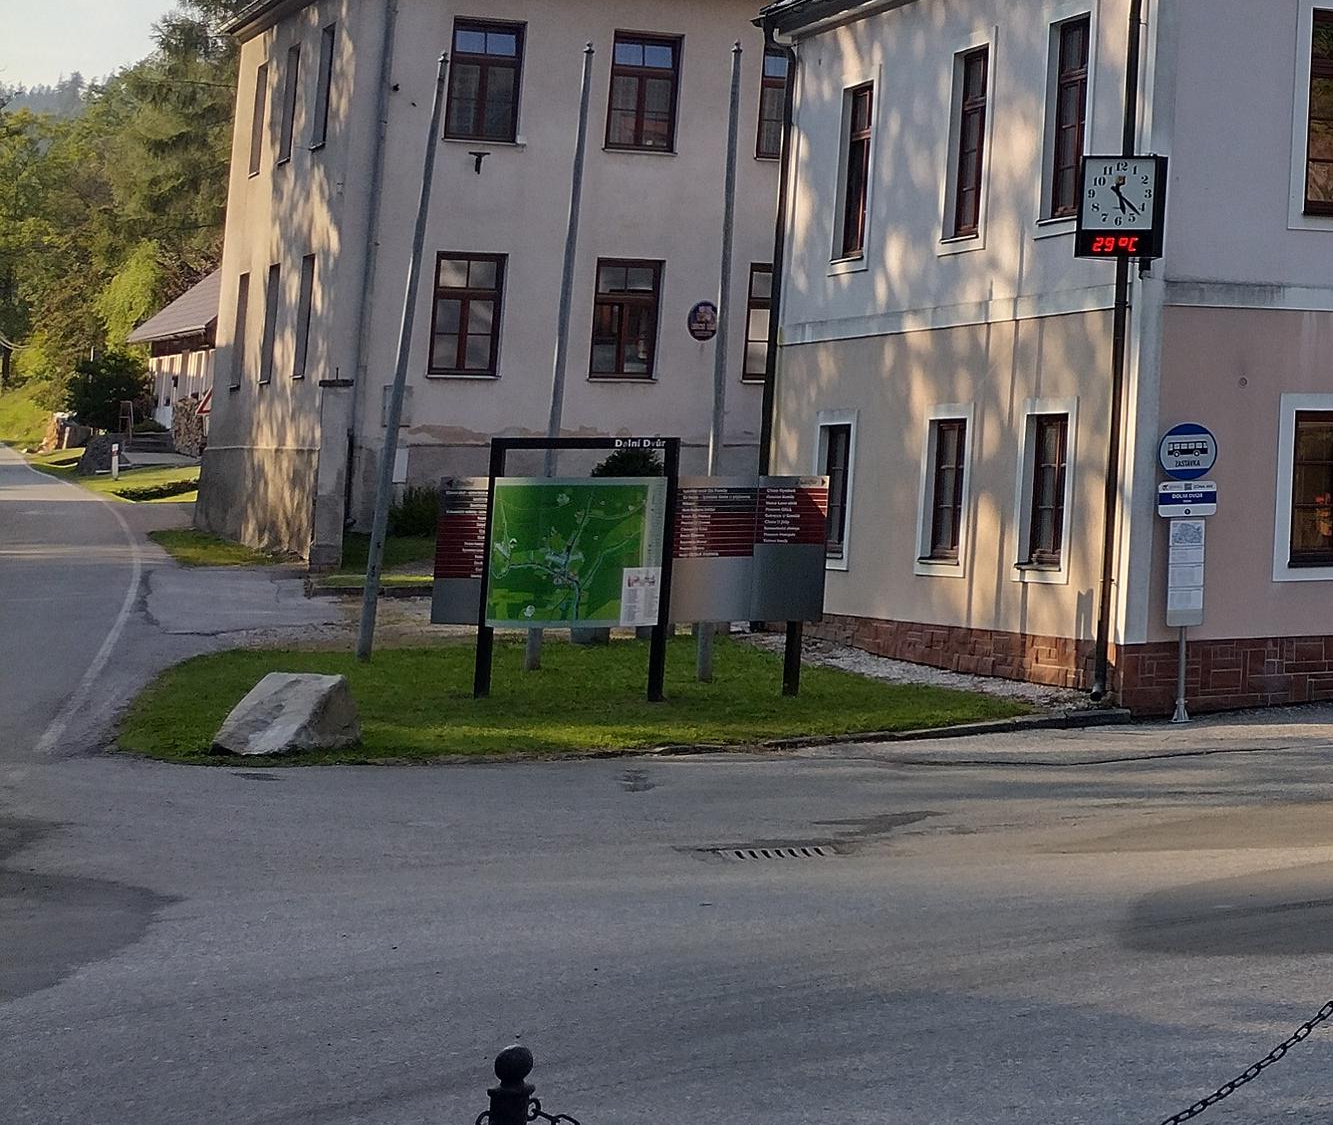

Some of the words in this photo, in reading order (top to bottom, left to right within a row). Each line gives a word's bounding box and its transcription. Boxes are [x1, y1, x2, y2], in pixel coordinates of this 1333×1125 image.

[1103, 166, 1113, 175] 11
[1116, 161, 1128, 171] 12
[1093, 176, 1106, 186] 10
[1141, 175, 1149, 184] 2
[1088, 189, 1096, 199] 9
[1144, 189, 1152, 199] 3
[1091, 202, 1100, 212] 8
[1101, 213, 1109, 222] 7
[1114, 216, 1122, 226] 6
[1128, 213, 1136, 222] 5
[1092, 237, 1115, 251] 29
